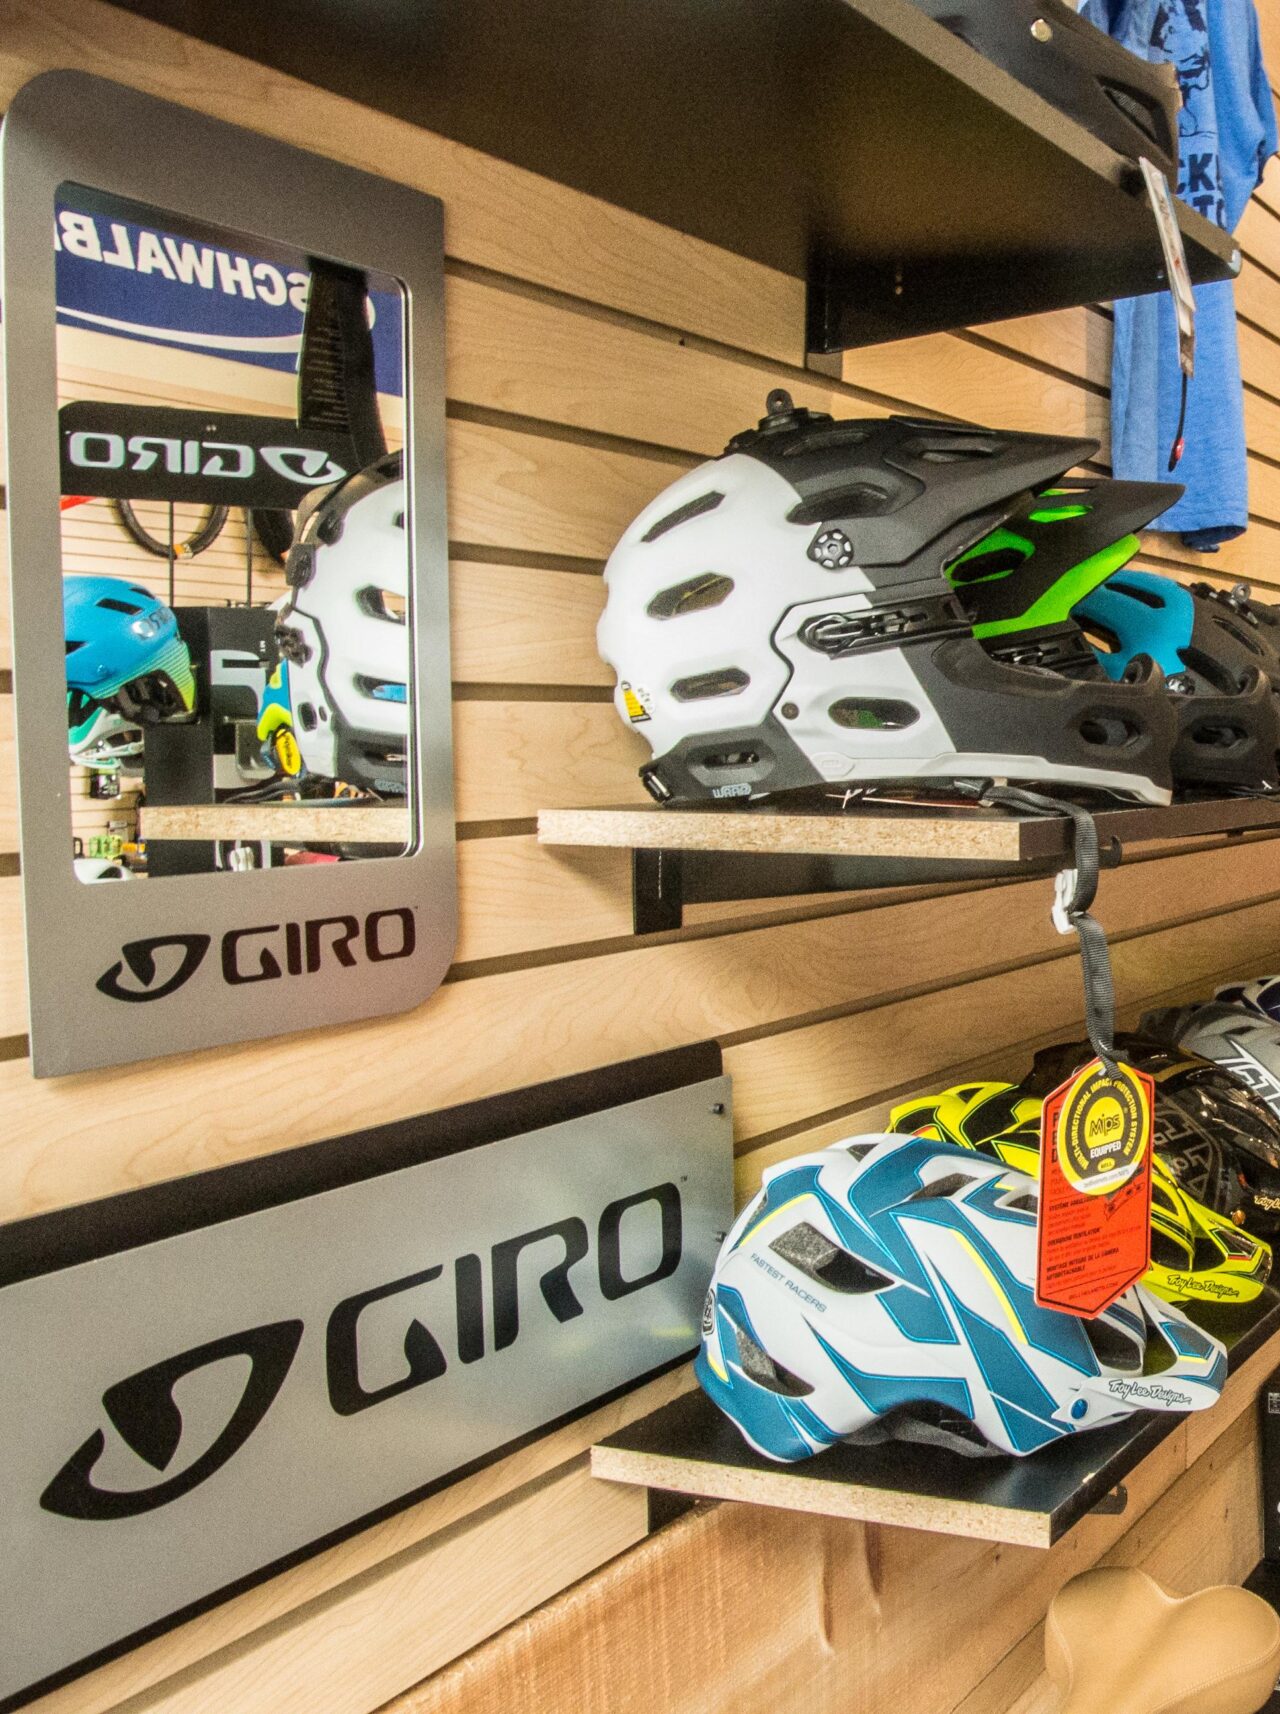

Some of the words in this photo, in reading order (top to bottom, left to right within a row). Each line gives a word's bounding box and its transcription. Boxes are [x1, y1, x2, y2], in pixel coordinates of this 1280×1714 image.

[221, 907, 416, 985] GIRO
[1090, 1141, 1122, 1159] EQUIPPED
[325, 1181, 683, 1416] GIRO
[750, 1253, 786, 1281] FASTEST
[785, 1279, 828, 1313] RACERS
[1109, 1379, 1129, 1400] Troy
[1128, 1382, 1150, 1395] Lee
[1150, 1386, 1192, 1407] Designs
